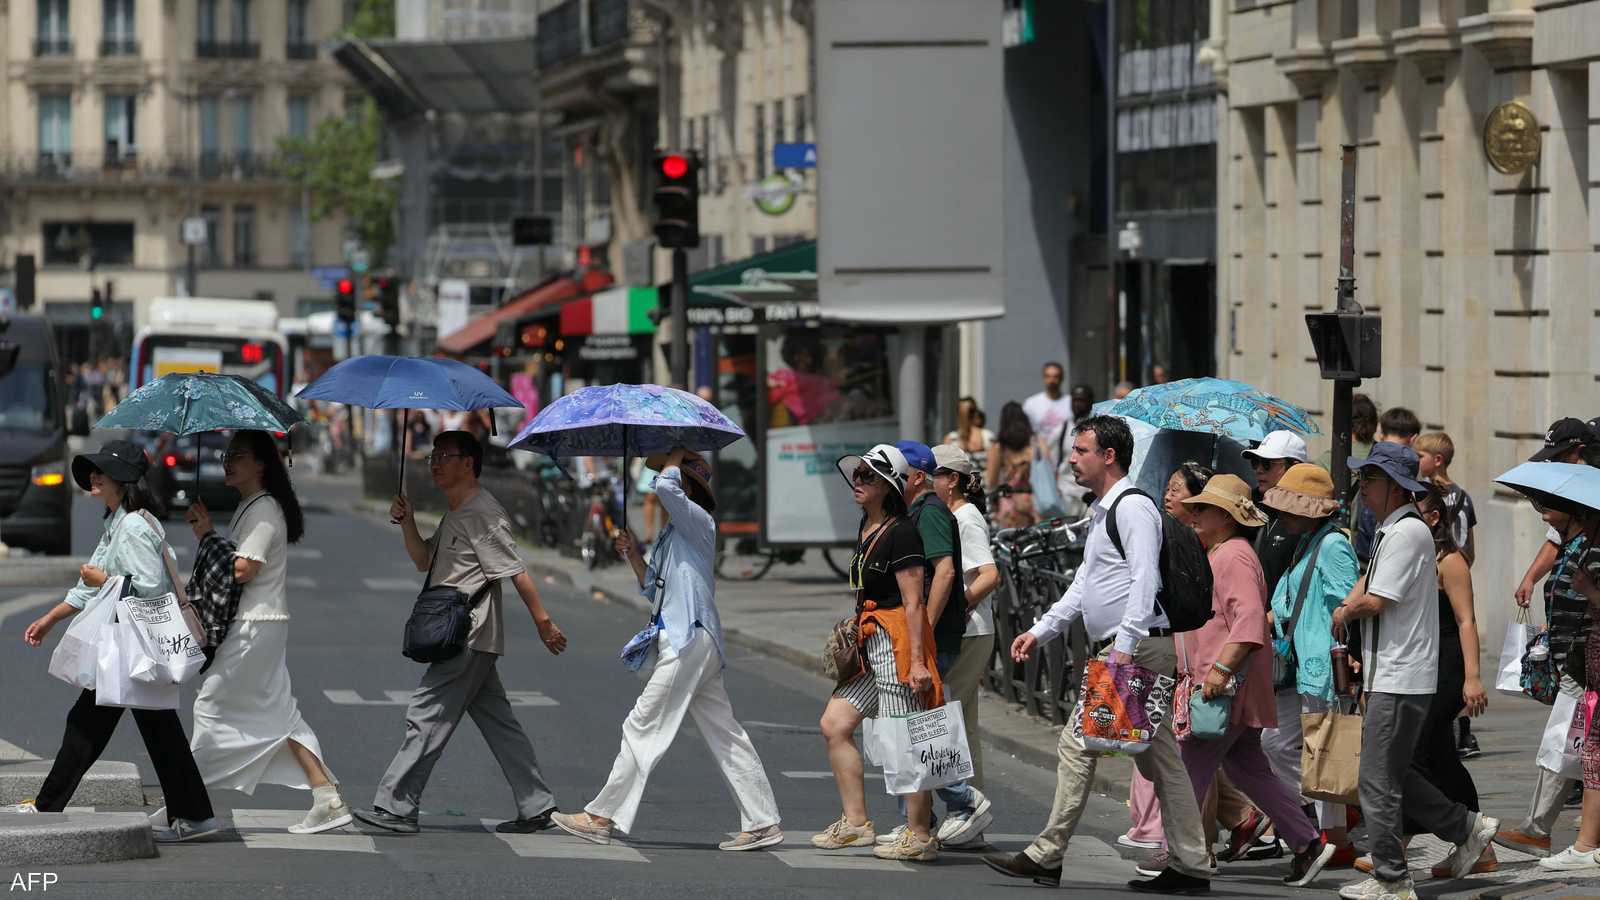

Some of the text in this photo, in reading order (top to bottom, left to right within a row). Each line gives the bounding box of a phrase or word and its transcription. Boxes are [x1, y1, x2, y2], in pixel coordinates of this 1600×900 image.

[725, 307, 754, 323] BIO
[908, 711, 946, 728] THE DEPARTMENT
[910, 725, 925, 735] STORE
[912, 726, 947, 743] NEVER SLEEPS
